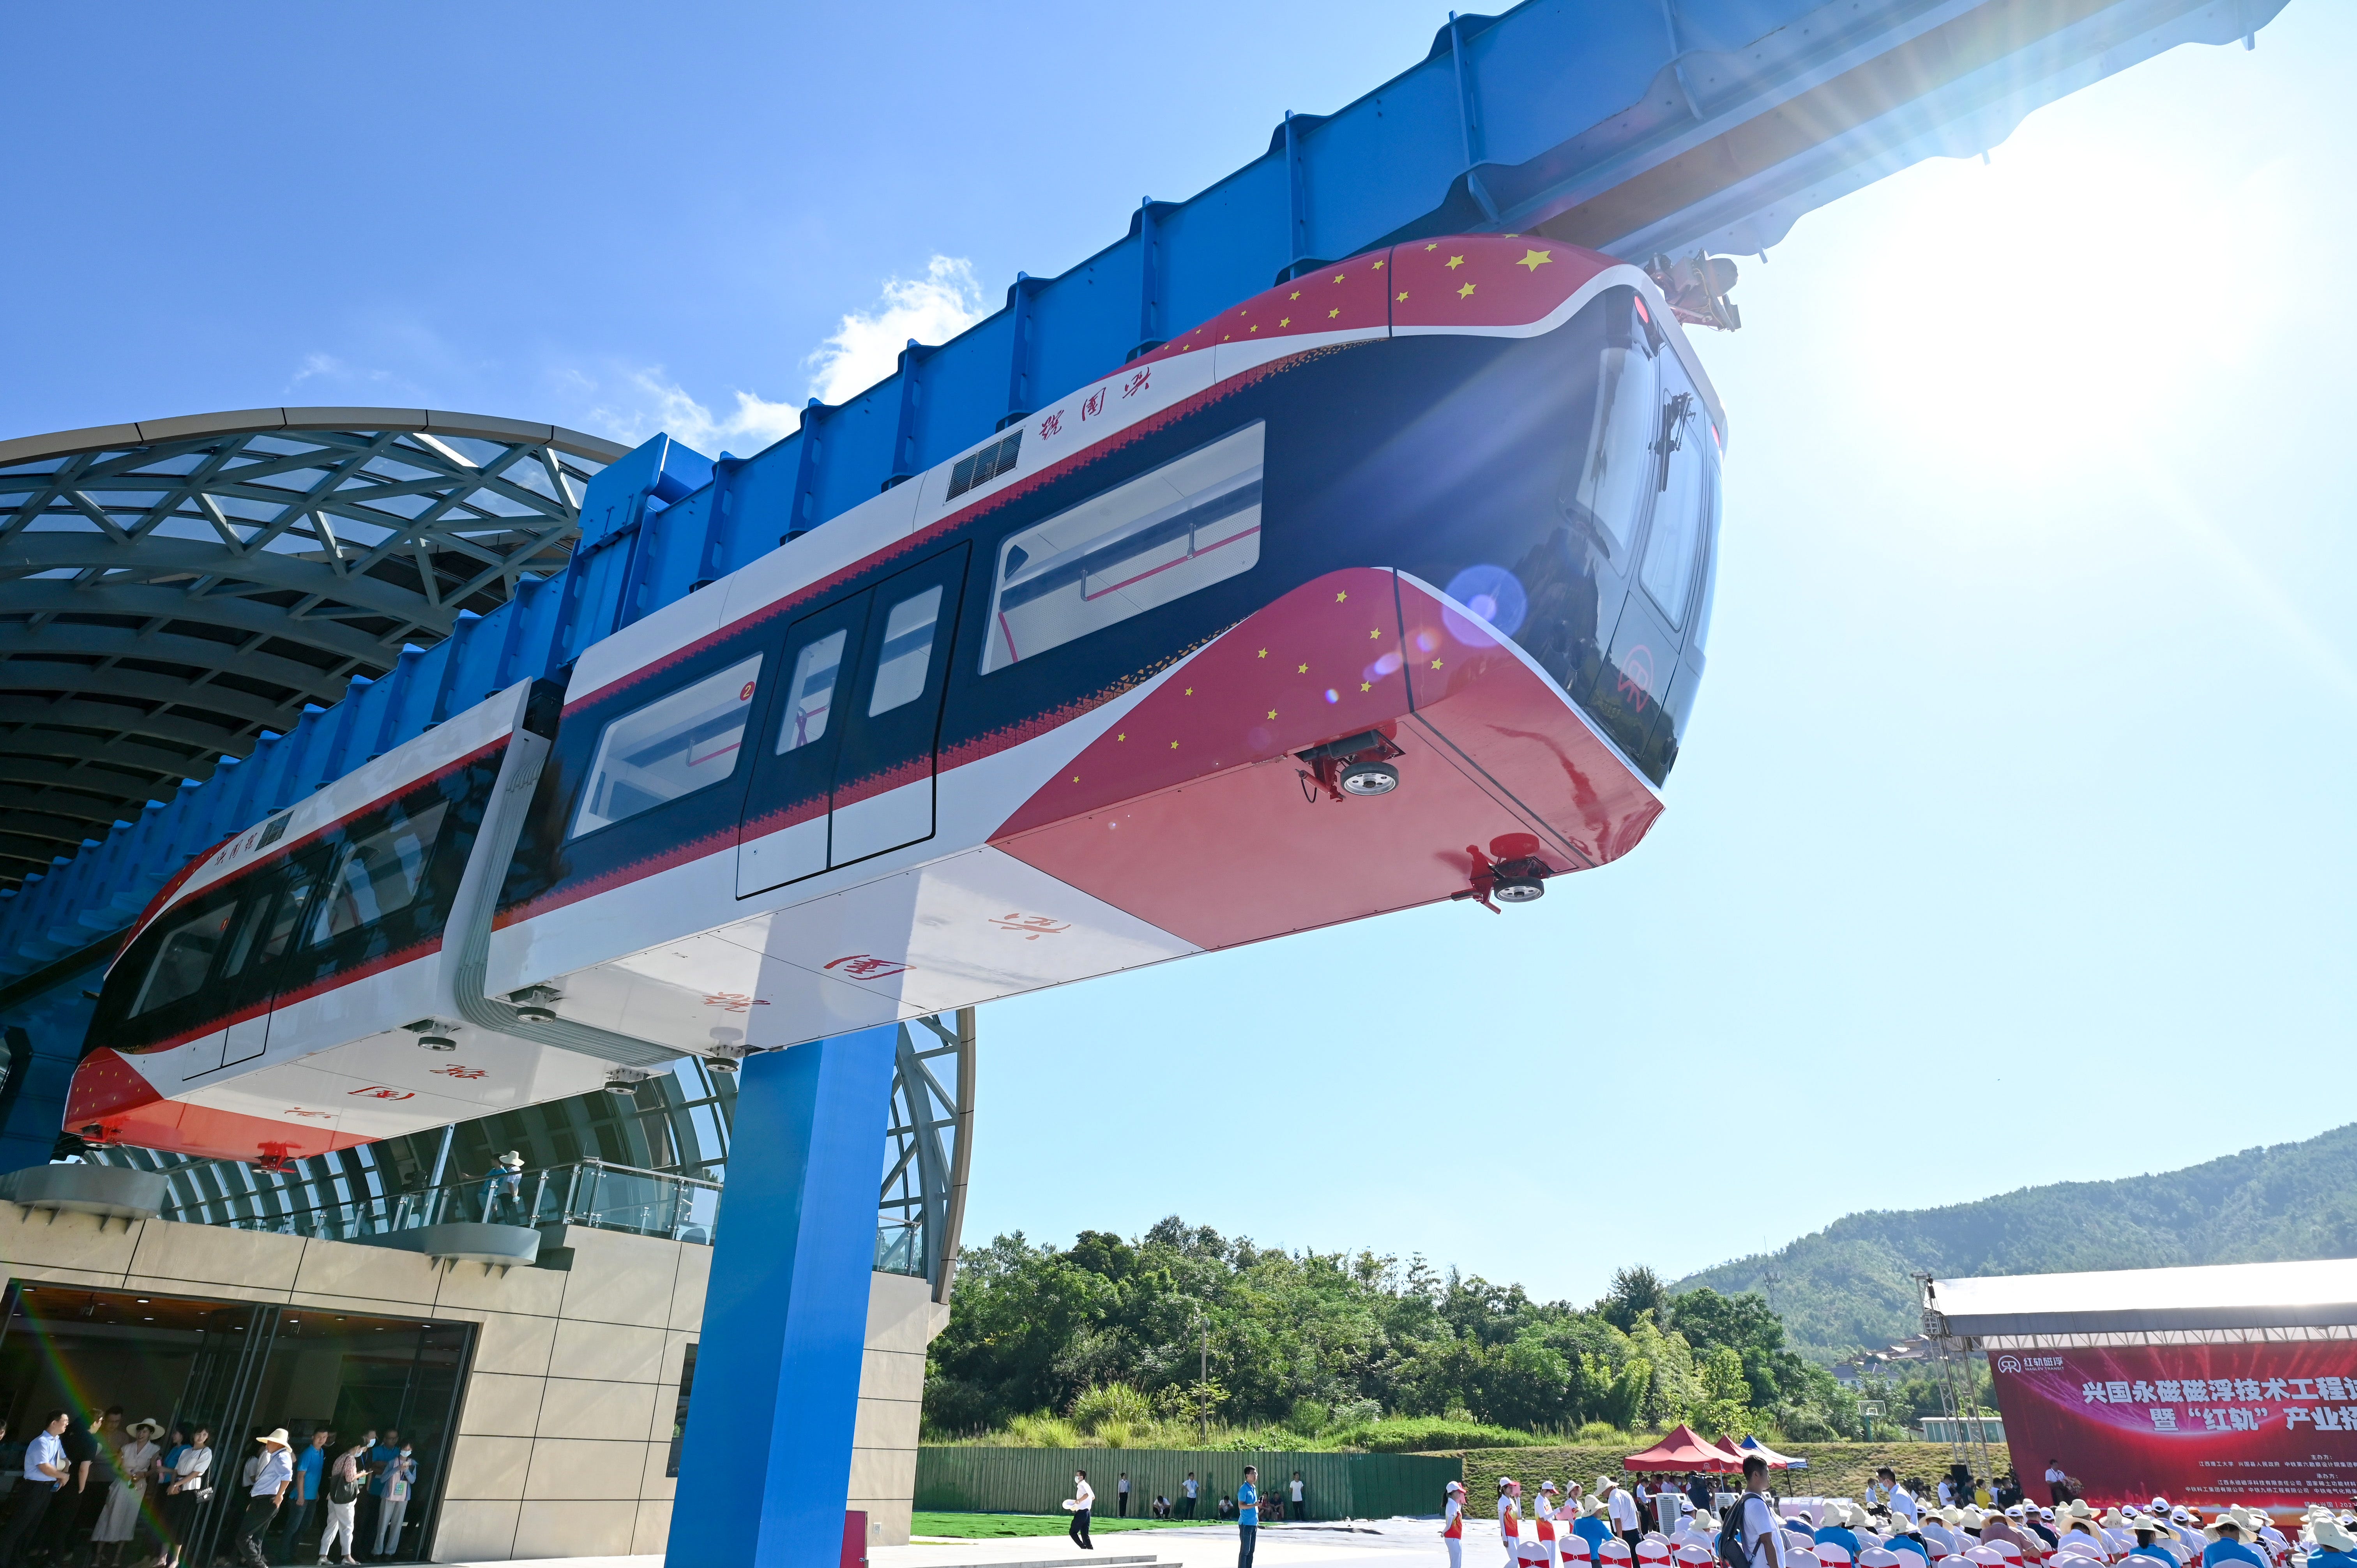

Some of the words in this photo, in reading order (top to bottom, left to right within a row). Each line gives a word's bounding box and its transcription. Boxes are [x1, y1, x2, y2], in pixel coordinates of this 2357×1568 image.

[743, 685, 751, 697] 2
[2023, 1357, 2063, 1367] 红轨磁浮
